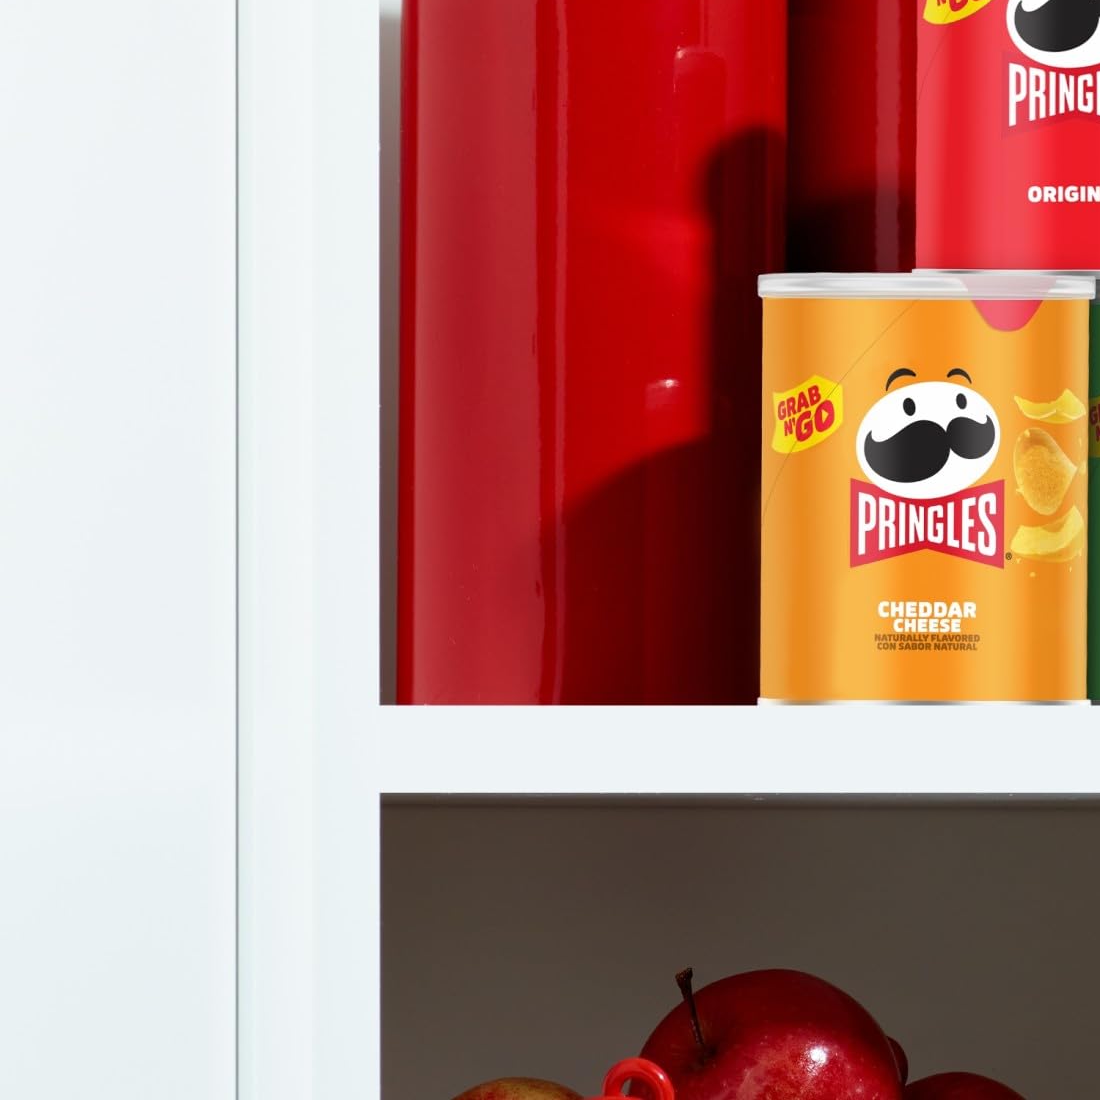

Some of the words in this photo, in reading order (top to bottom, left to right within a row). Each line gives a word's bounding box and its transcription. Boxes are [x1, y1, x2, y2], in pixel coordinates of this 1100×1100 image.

[778, 385, 821, 420] GRAB
[857, 491, 997, 557] PRINGLES
[877, 600, 977, 618] CHEDDAR
[893, 618, 961, 633] CHEESE
[874, 633, 929, 643] NATURALLY
[931, 633, 981, 643] FLAVORED
[877, 642, 897, 651] CON
[899, 642, 932, 651] SABOR
[934, 642, 978, 651] NATURAL
